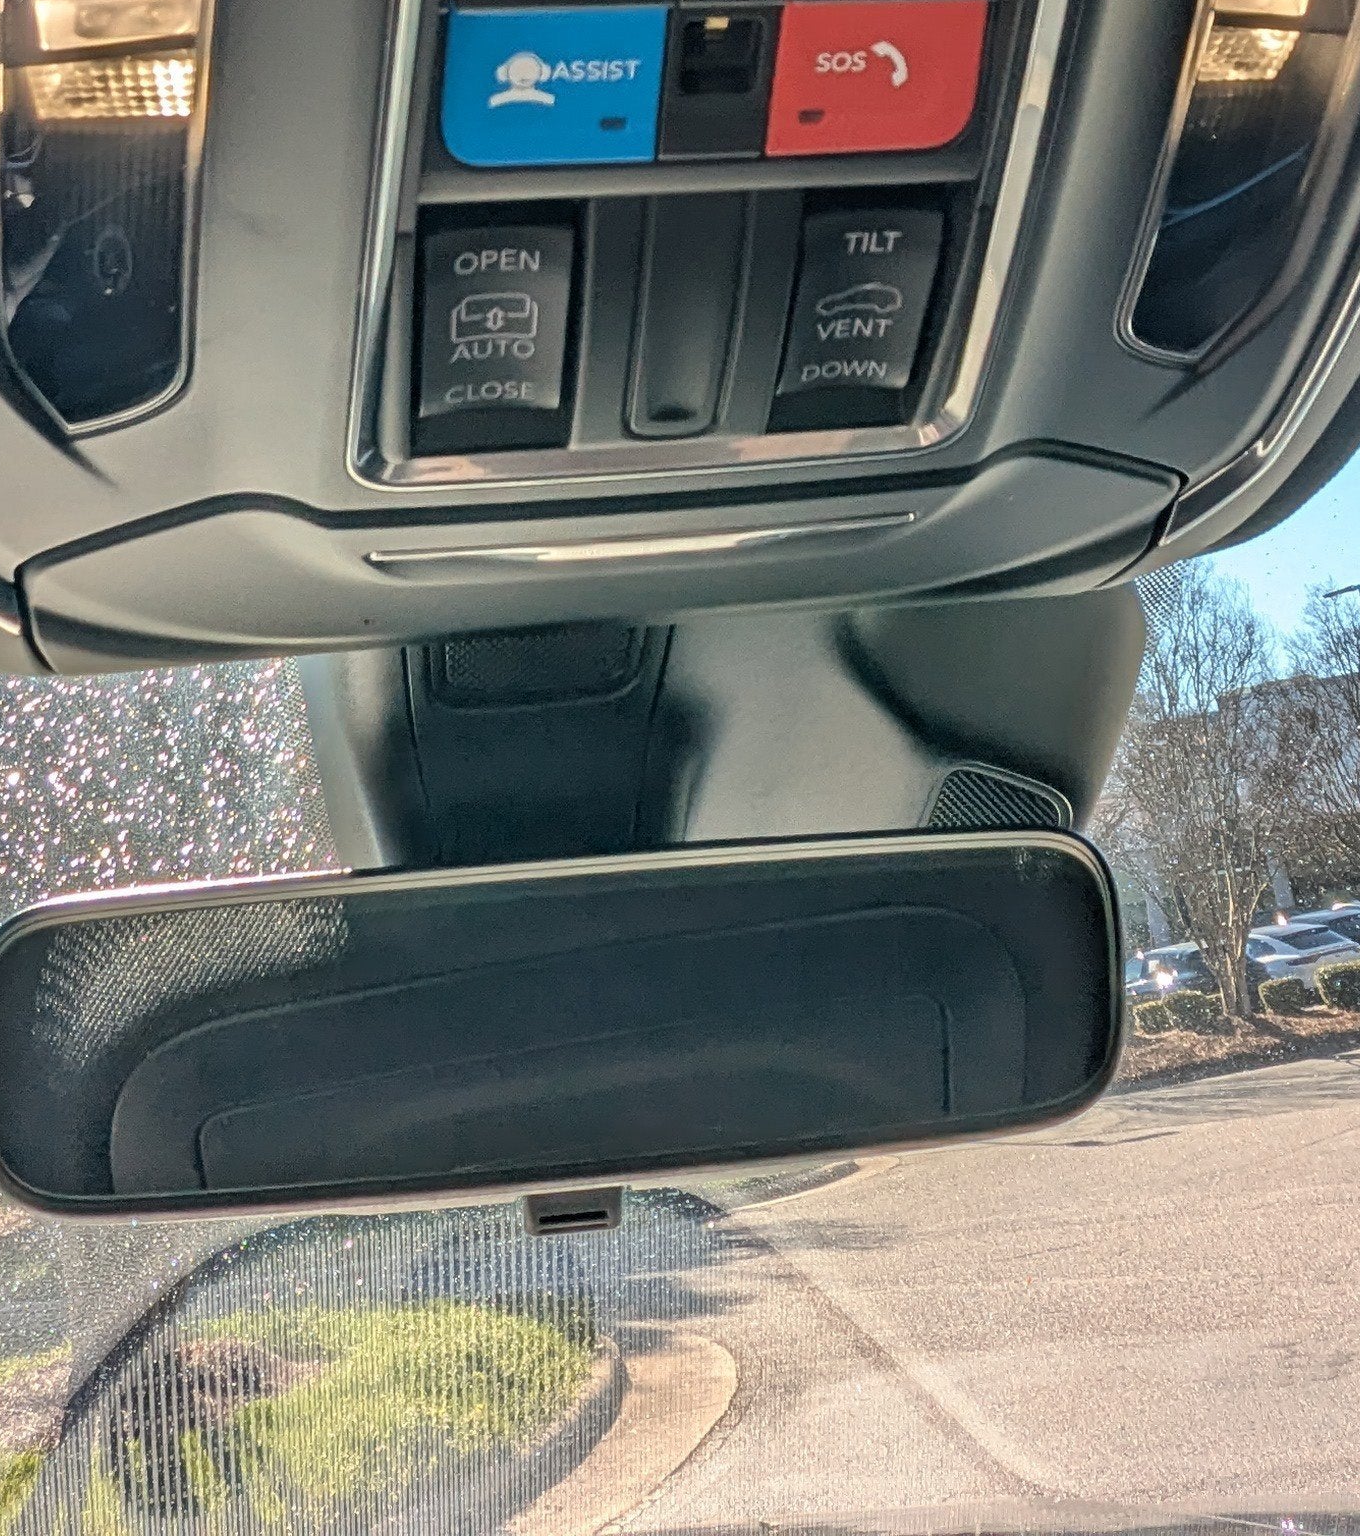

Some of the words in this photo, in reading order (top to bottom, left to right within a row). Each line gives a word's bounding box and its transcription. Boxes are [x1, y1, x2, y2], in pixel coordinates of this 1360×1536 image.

[551, 59, 642, 82] ASSIST
[815, 51, 867, 73] SOS
[845, 231, 902, 254] TILT
[454, 249, 541, 276] OPEN
[817, 318, 894, 341] VENT
[450, 339, 536, 363] AUTO
[801, 359, 888, 383] DOWN
[444, 381, 535, 405] CLOSE
